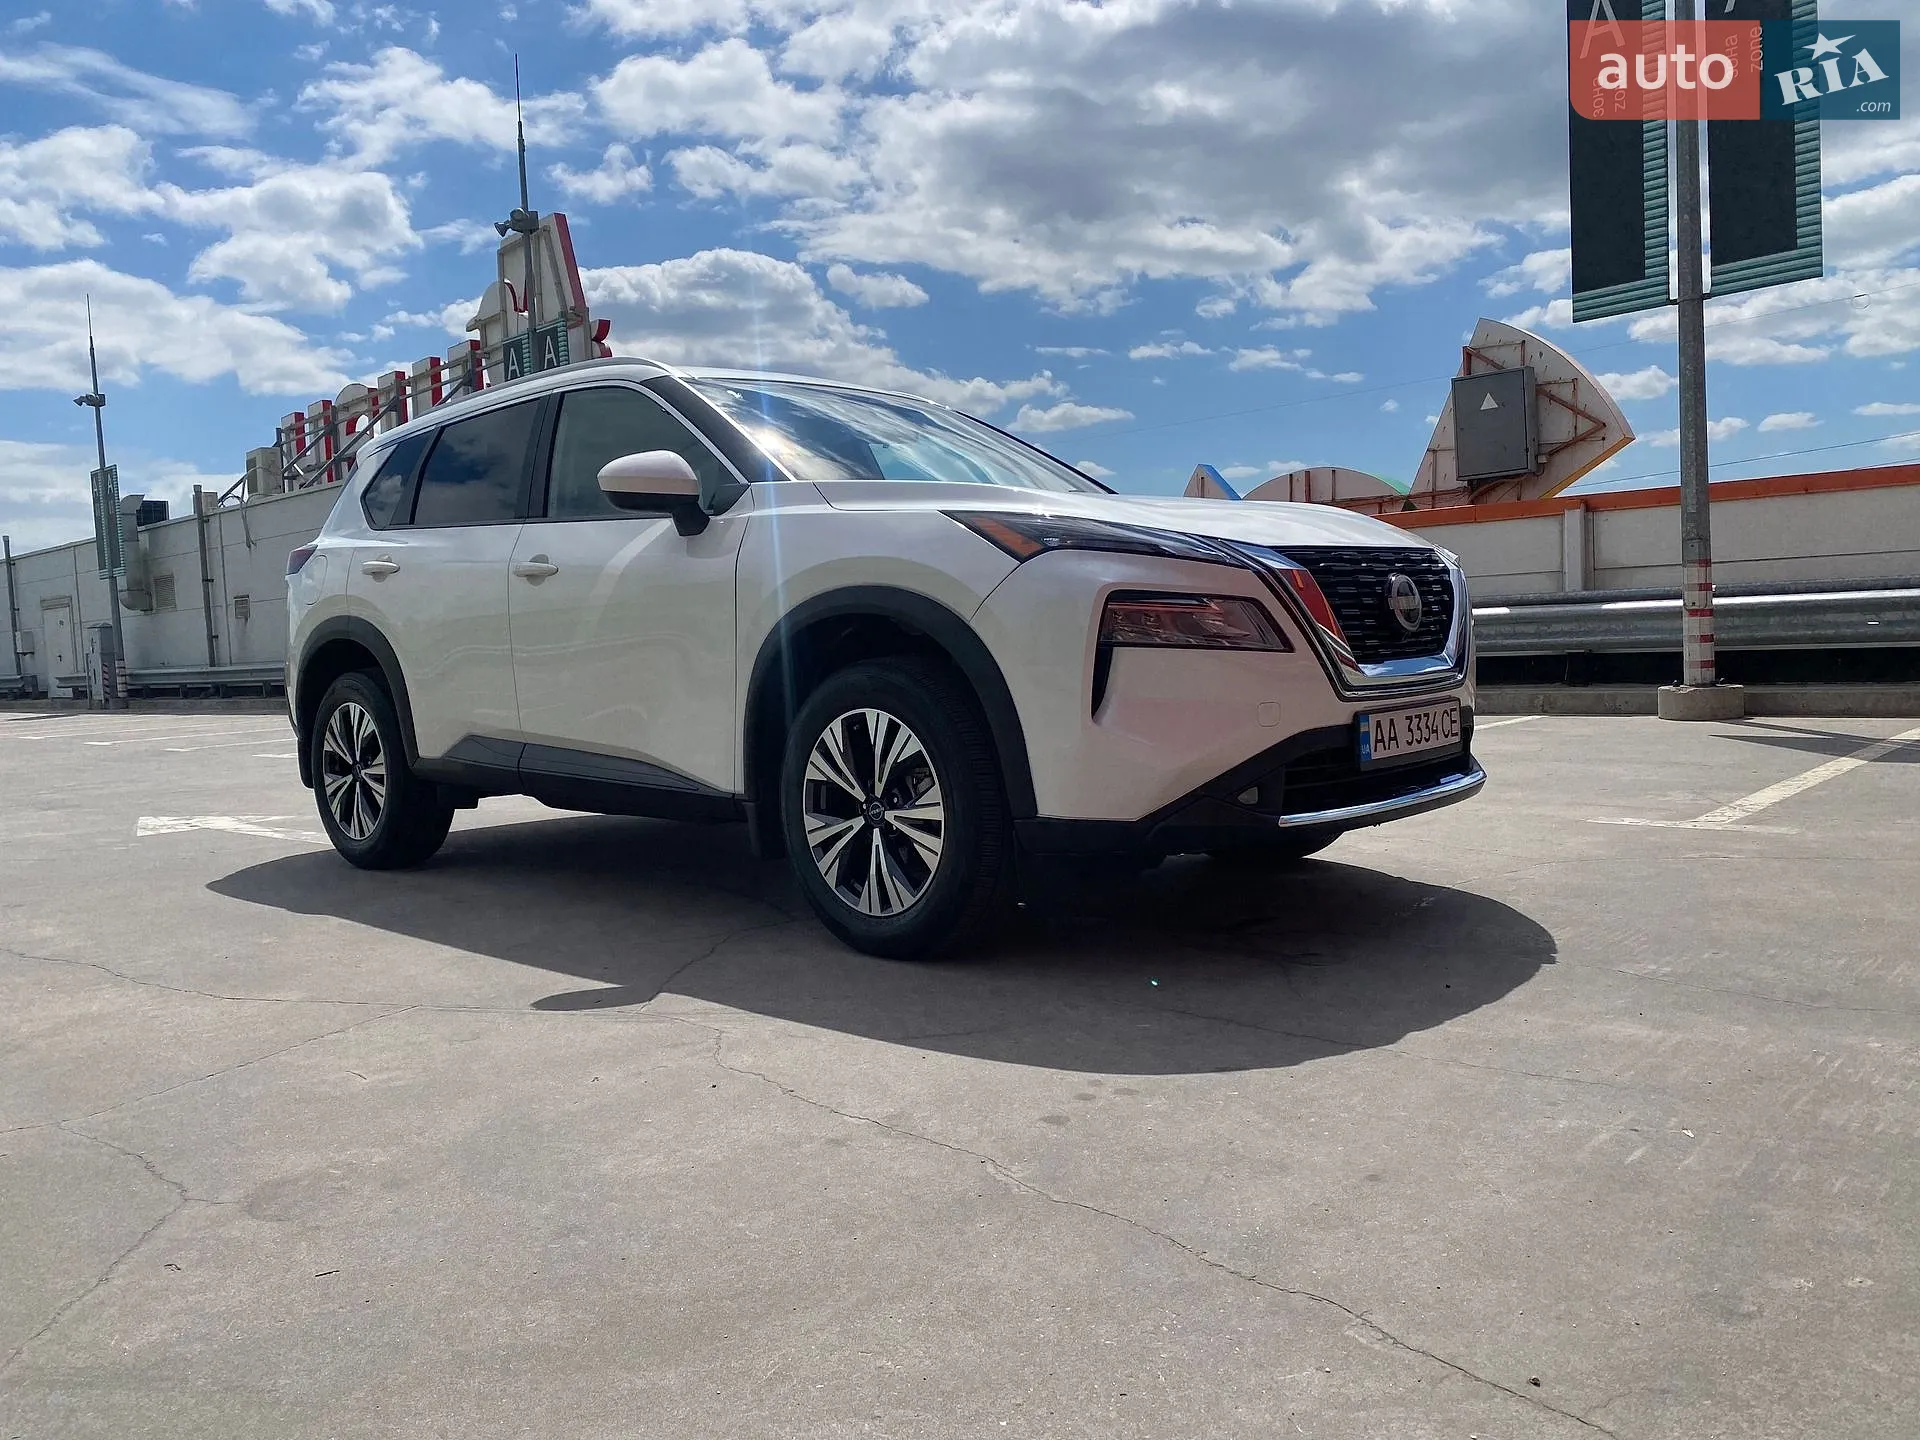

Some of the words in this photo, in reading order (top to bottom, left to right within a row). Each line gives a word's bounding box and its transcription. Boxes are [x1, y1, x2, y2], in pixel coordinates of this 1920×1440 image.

[1374, 719, 1399, 752] AA
[1405, 711, 1439, 746] 3334
[1441, 707, 1459, 739] CE
